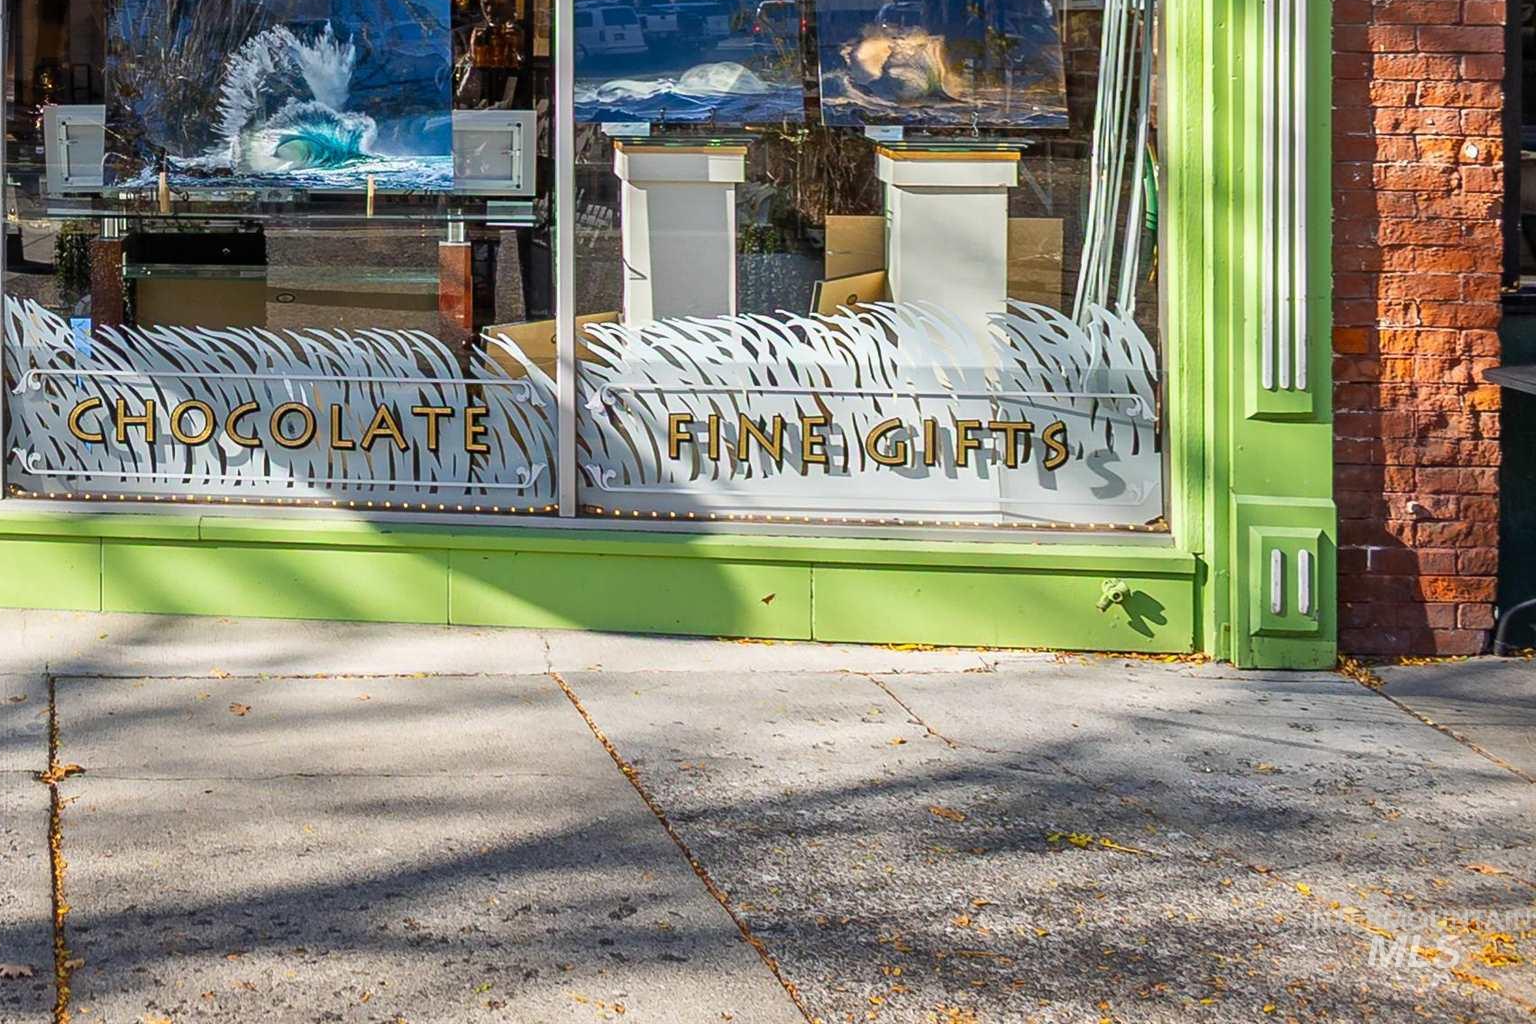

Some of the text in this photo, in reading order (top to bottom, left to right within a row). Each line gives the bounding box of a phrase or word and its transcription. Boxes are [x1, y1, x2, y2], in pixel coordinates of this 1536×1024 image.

[67, 396, 491, 455] CHOCOLATE
[667, 411, 1070, 472] FINE GIFTS
